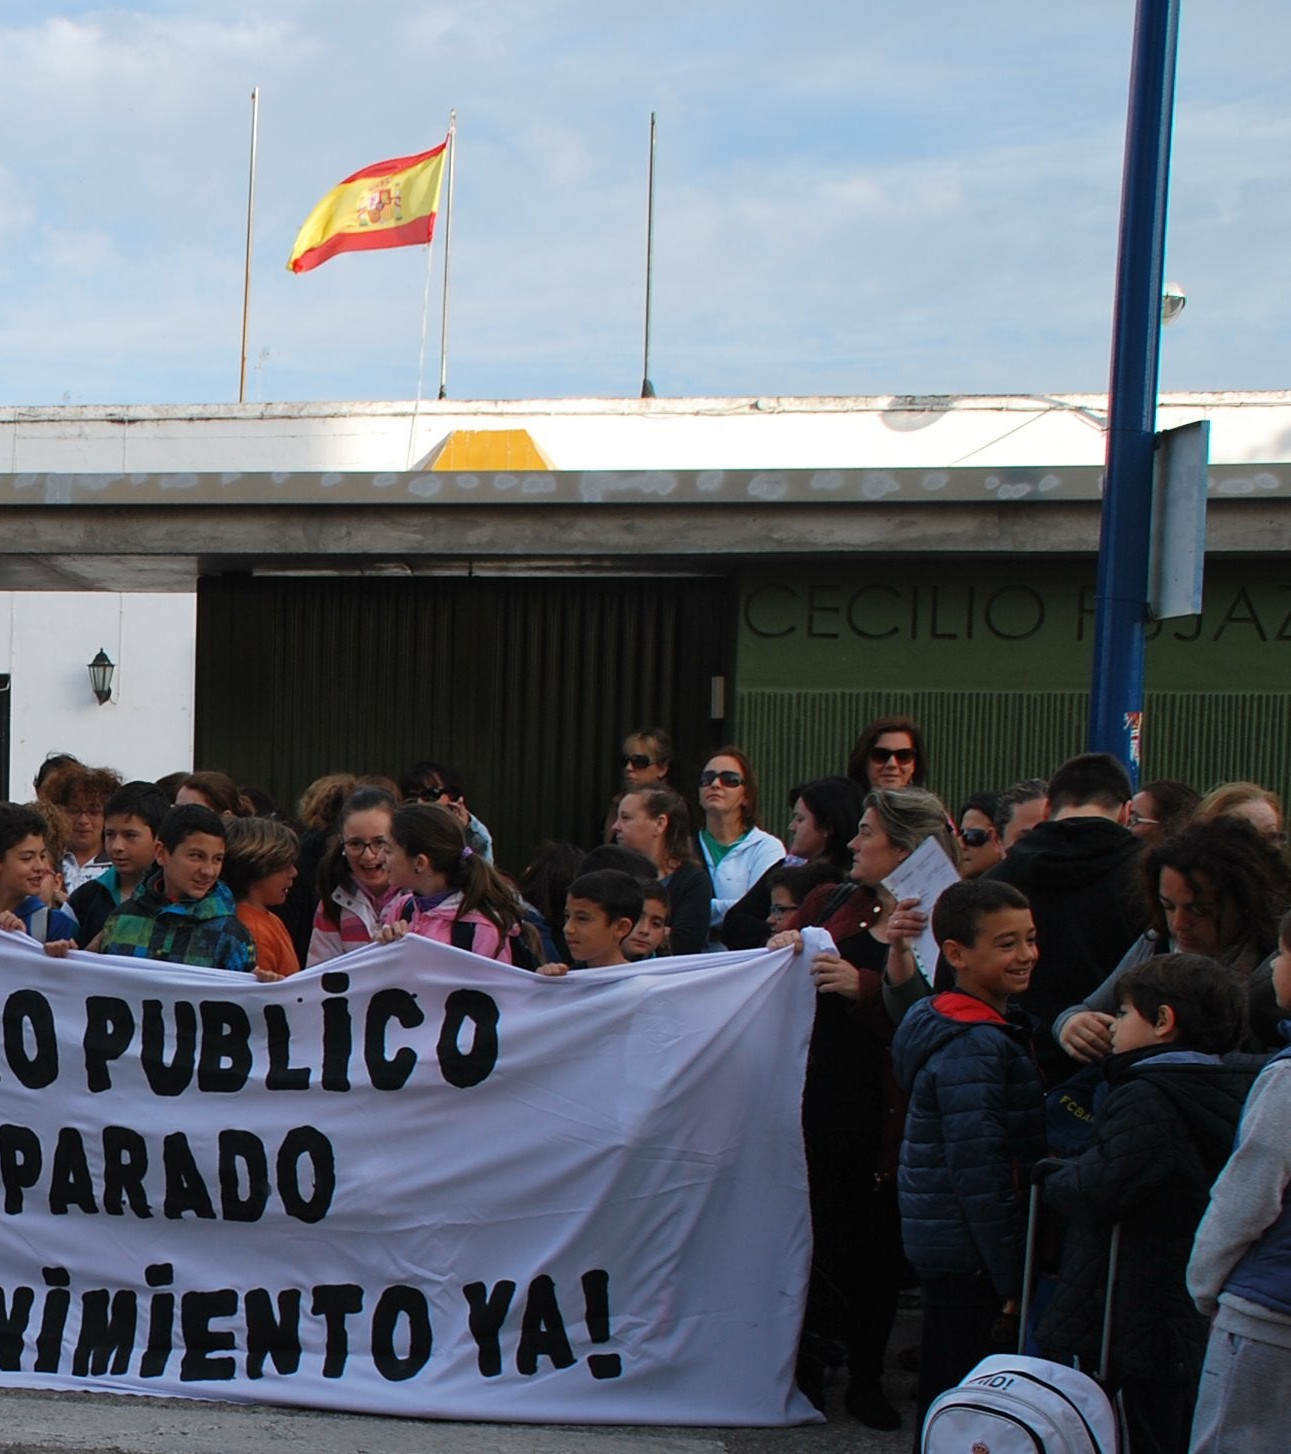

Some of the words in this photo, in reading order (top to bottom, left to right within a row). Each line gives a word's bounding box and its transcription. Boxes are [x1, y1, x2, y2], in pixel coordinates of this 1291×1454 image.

[743, 583, 1046, 642] CECILIO
[82, 972, 500, 1097] PUBLICO
[463, 1268, 622, 1380] YA!
